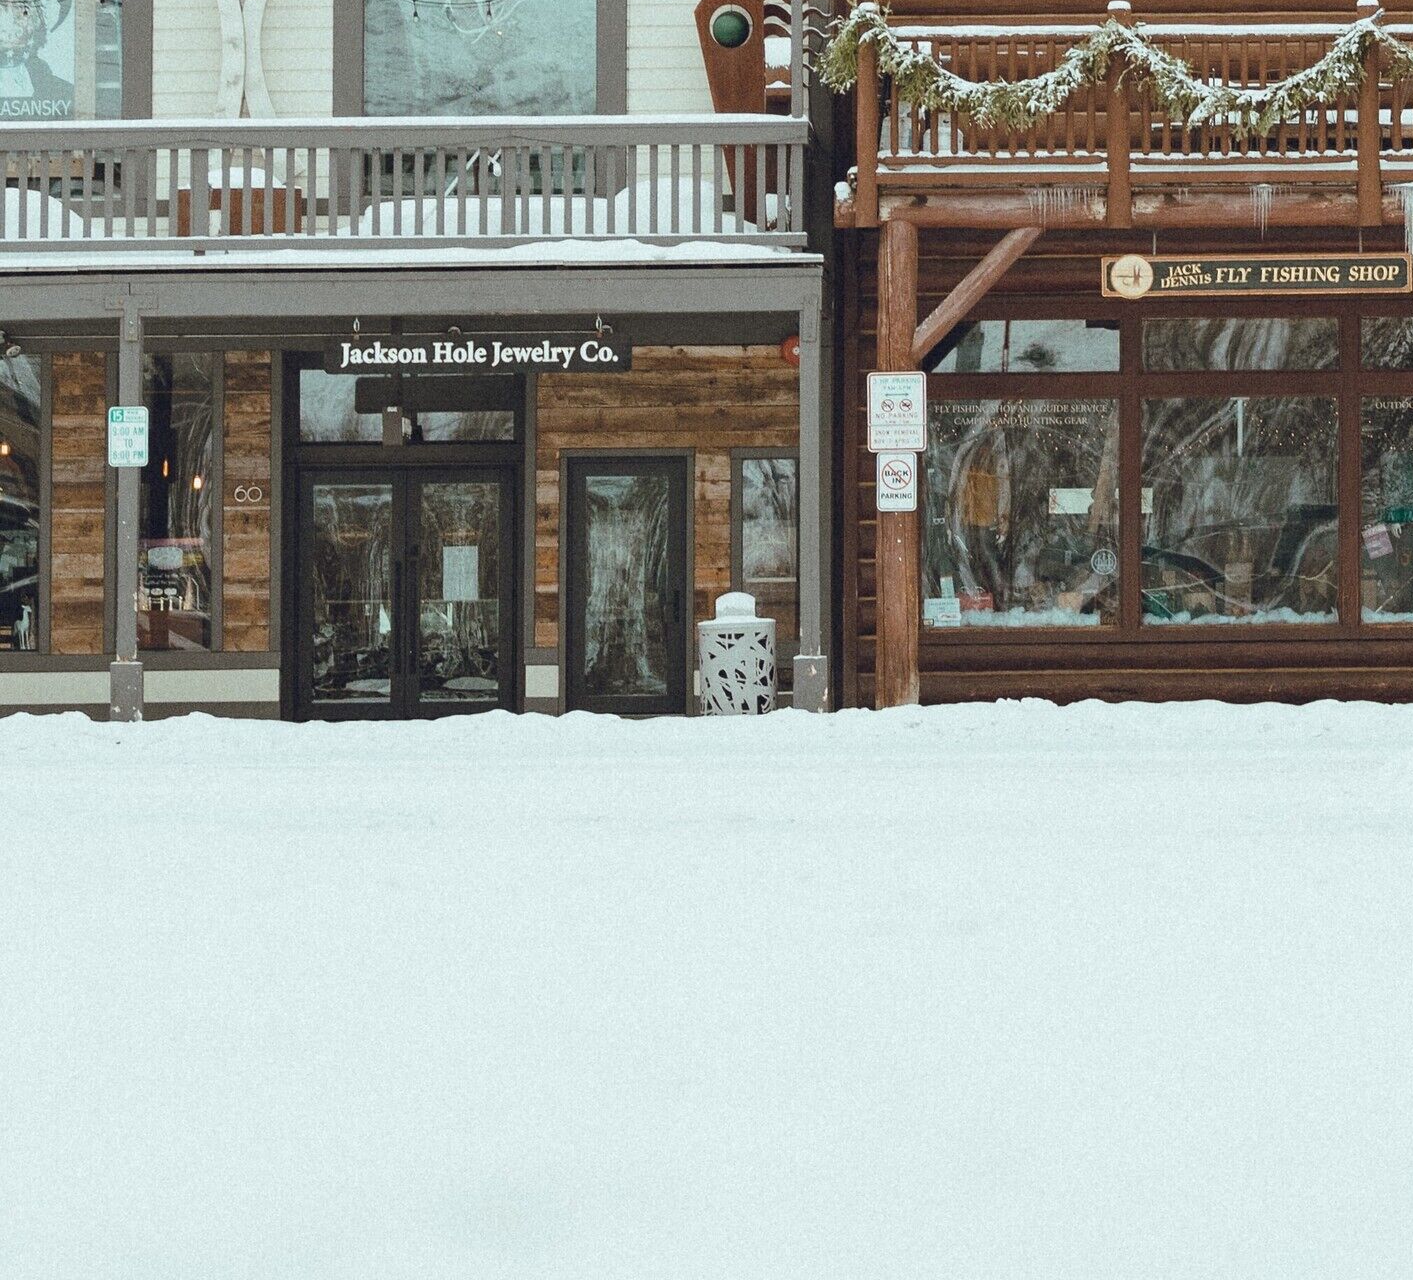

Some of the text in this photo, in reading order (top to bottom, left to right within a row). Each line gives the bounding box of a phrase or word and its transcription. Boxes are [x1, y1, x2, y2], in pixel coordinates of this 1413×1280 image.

[0, 100, 71, 116] ASANSKY
[1167, 263, 1202, 277] JACK
[1215, 264, 1400, 283] FLY FISHING SHOP
[1161, 275, 1212, 289] DENNIS
[340, 339, 620, 369] Jackson Hole Jewelry Co.
[935, 405, 950, 413] FLY
[952, 405, 987, 413] FISHING
[1018, 404, 1038, 413] AND
[1040, 404, 1069, 413] GUIDE
[1070, 404, 1108, 413] SERVICE
[112, 410, 123, 421] 15
[1020, 416, 1063, 425] HUNTING
[1064, 416, 1088, 425] GEAR
[133, 426, 145, 436] AM
[123, 439, 133, 448] TO
[133, 450, 145, 460] PM
[234, 485, 262, 503] 60
